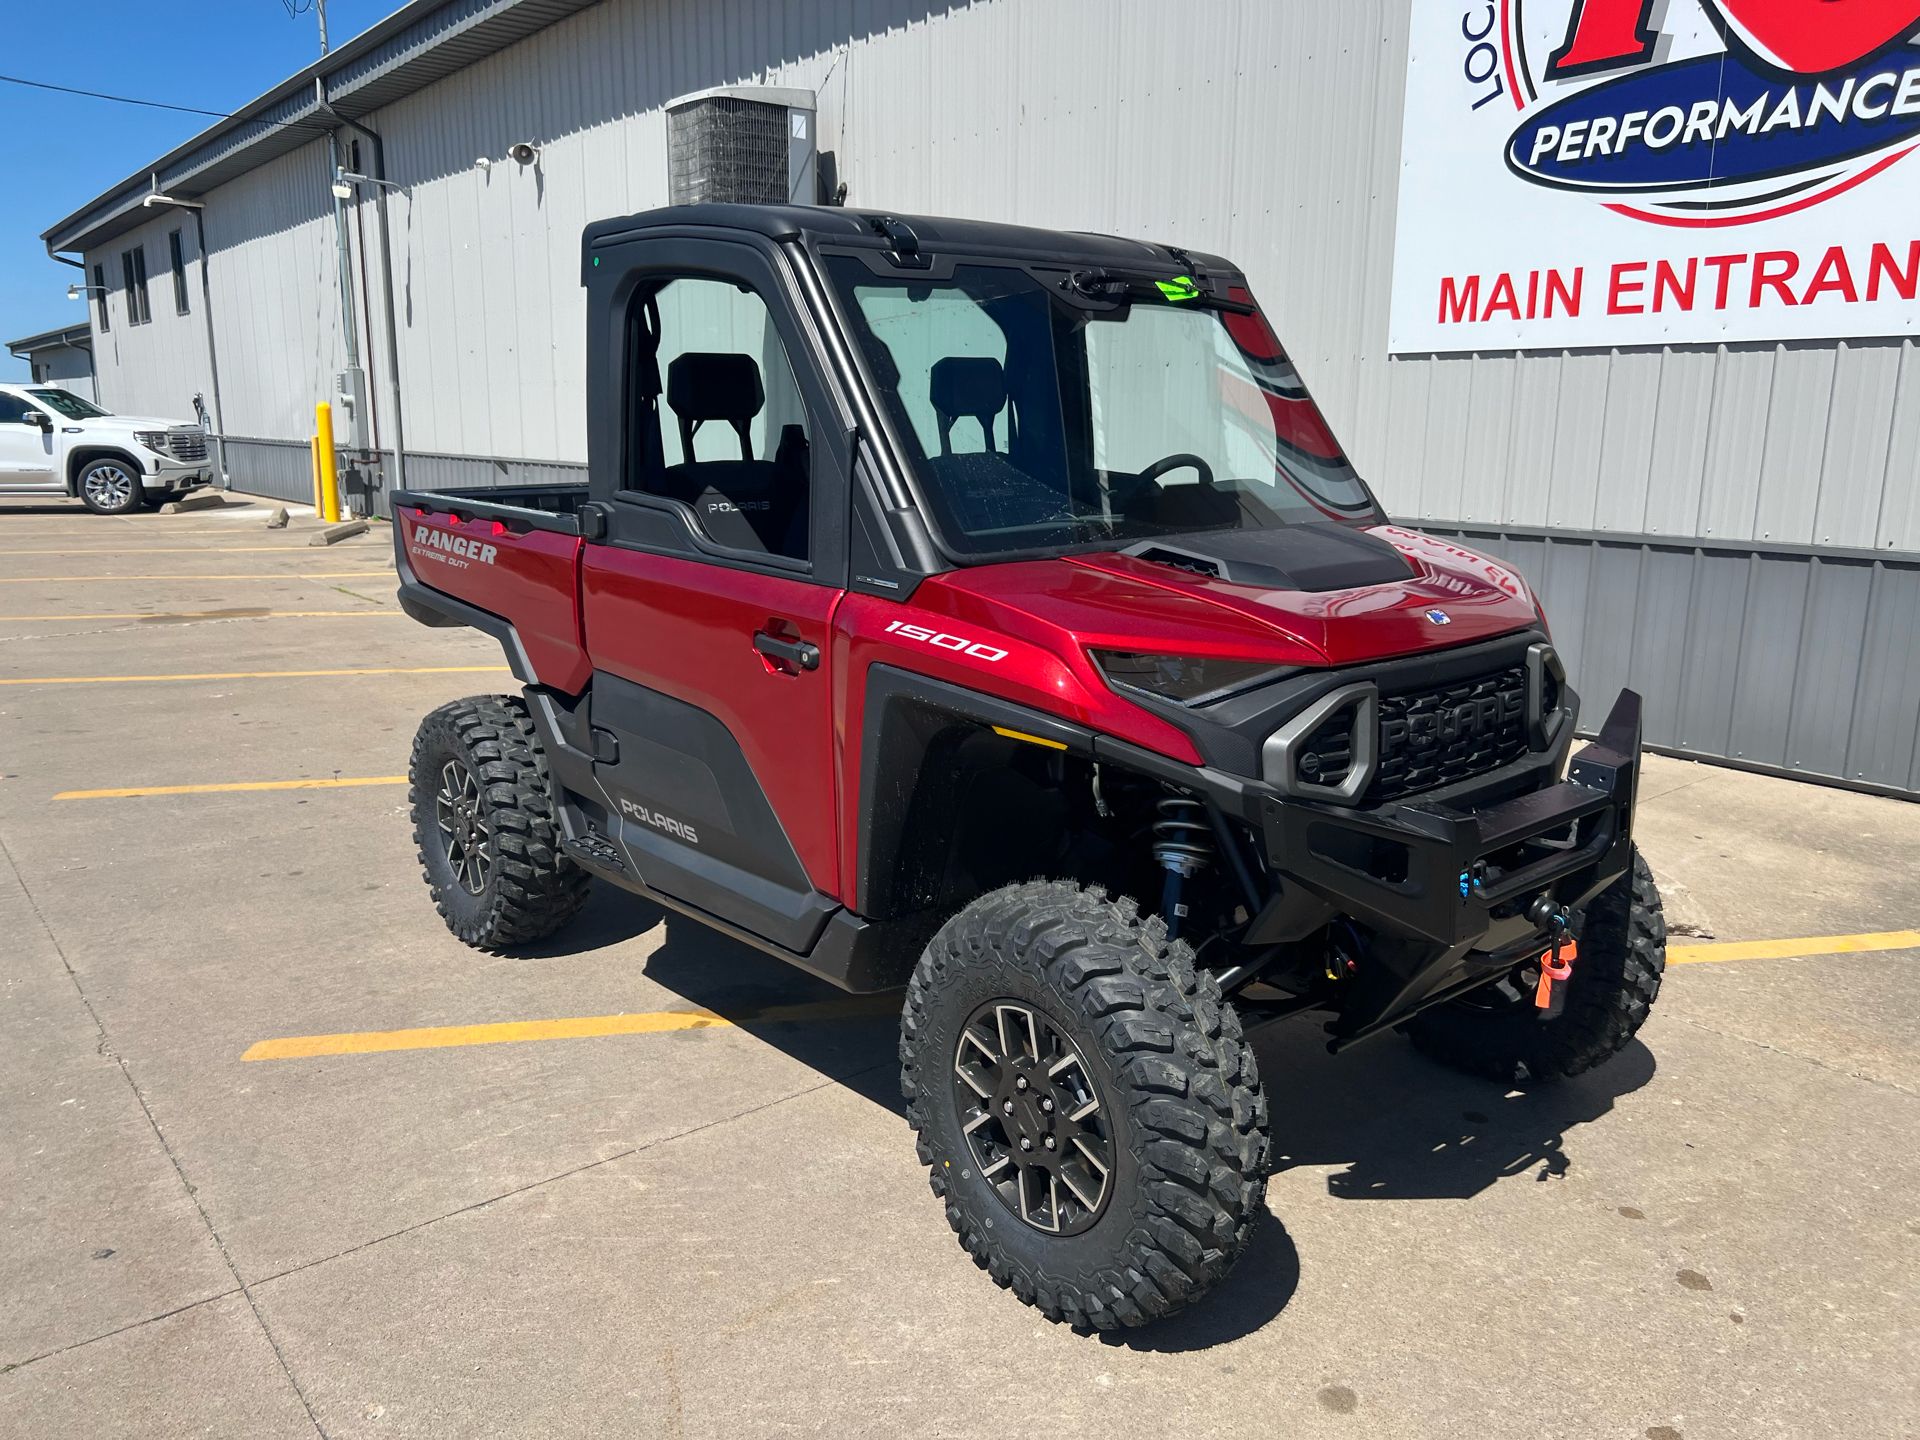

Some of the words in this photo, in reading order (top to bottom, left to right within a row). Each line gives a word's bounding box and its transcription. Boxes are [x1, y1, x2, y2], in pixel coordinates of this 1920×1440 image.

[1462, 0, 1504, 111] LOC
[1527, 68, 1920, 166] PERFORMANCE
[1438, 266, 1584, 324] MAIN
[1606, 240, 1920, 316] ENTRAN
[707, 501, 770, 514] POLARIS
[412, 546, 447, 563] EXTREME
[448, 557, 470, 570] DUTY
[414, 525, 498, 565] RANGER
[884, 620, 1009, 662] 1500
[1380, 688, 1524, 755] POLARIS
[620, 798, 699, 844] POLARIS
